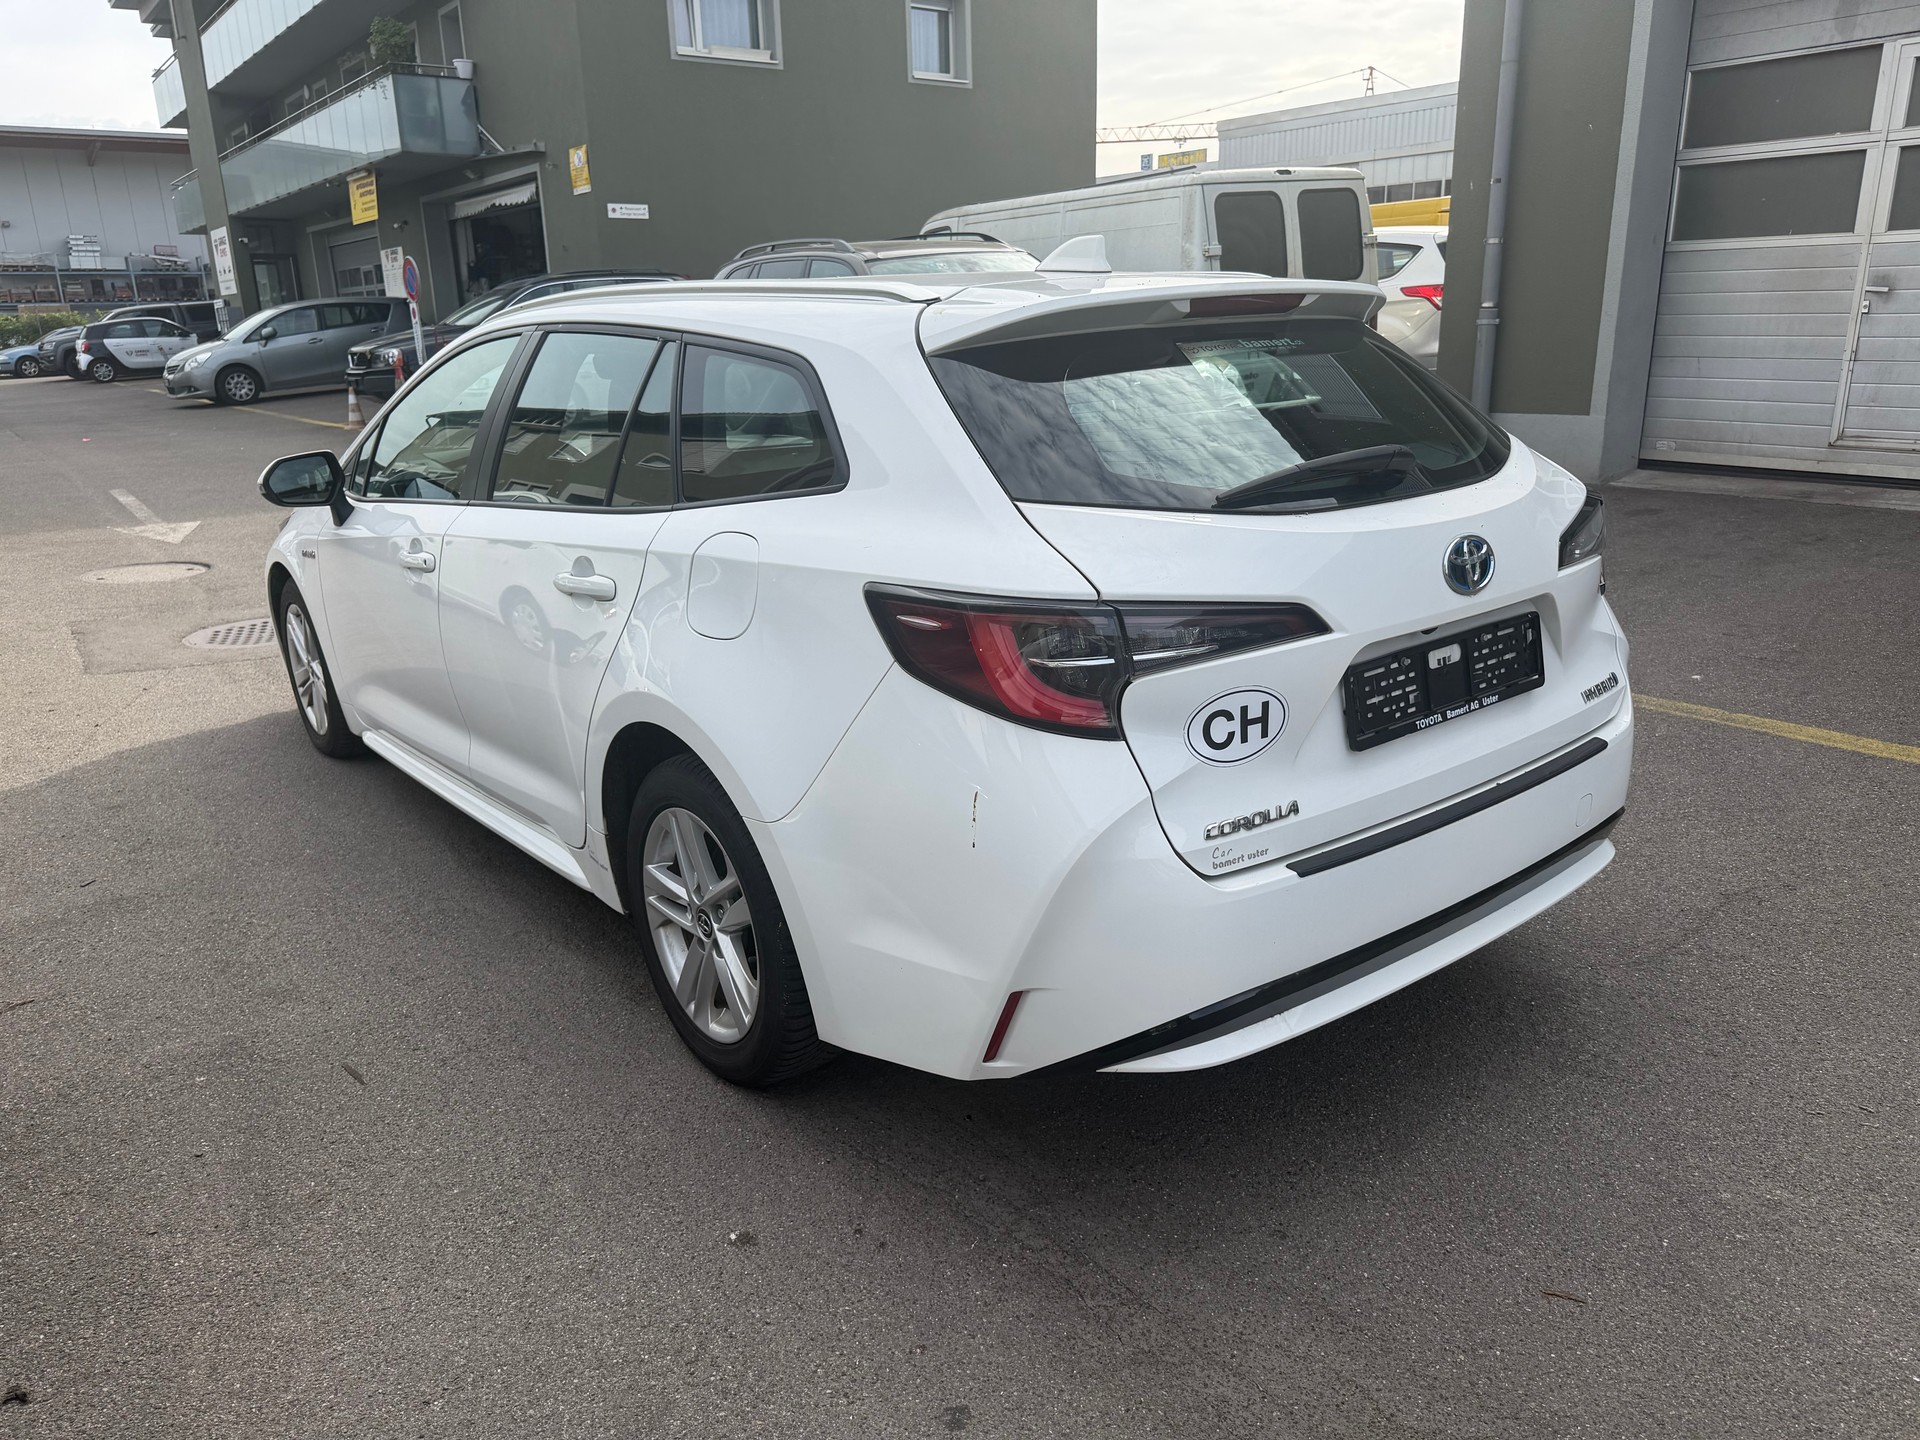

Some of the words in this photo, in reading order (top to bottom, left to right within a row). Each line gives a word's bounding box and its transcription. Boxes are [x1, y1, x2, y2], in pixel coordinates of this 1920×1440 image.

[1202, 700, 1269, 750] CH
[1415, 713, 1443, 730] TOYOTA
[1446, 705, 1470, 719] Bamert
[1470, 701, 1479, 711] AG
[1482, 695, 1499, 706] Uster
[1203, 799, 1300, 841] COROLLA
[1212, 847, 1232, 859] Car
[1212, 854, 1245, 870] bamert
[1247, 848, 1269, 860] uster
